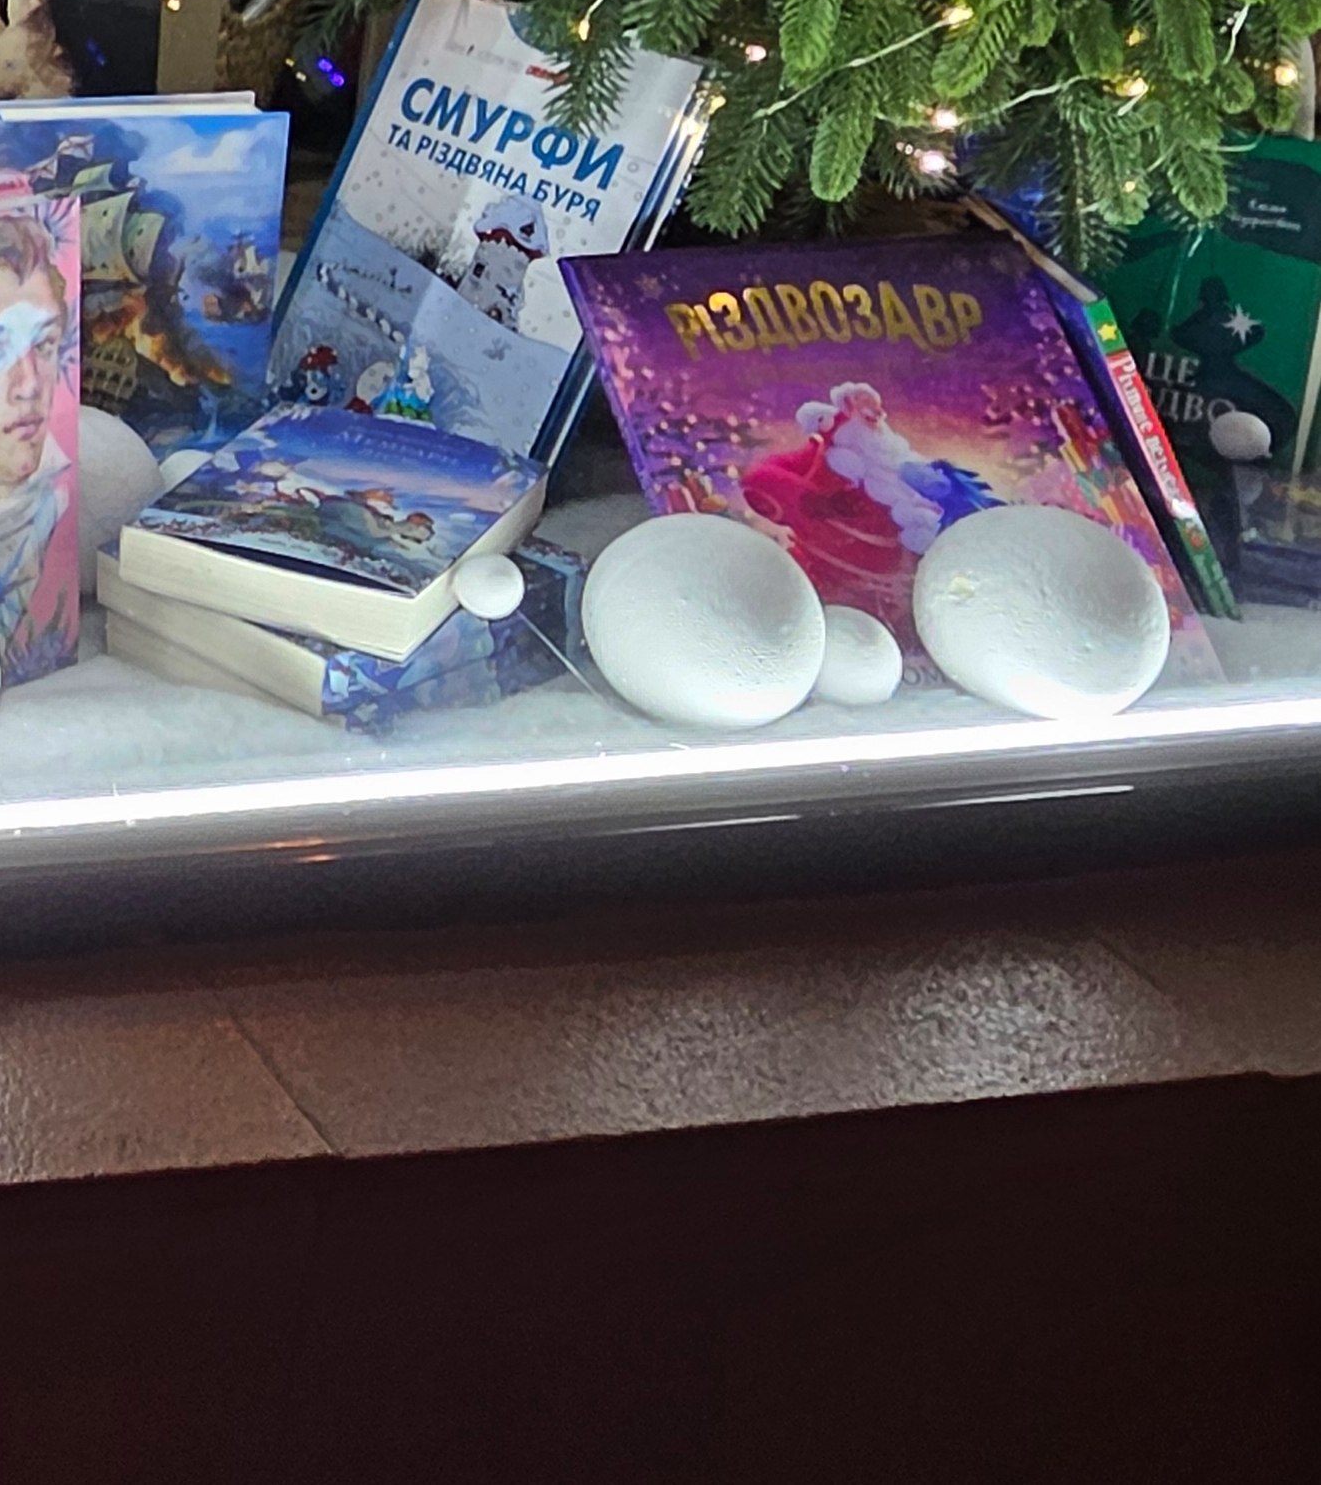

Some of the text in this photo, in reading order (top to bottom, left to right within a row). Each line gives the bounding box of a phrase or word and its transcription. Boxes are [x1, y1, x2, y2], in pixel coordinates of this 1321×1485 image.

[387, 123, 602, 223] ТА РІЗДВЯНА БУРЯ
[401, 77, 625, 191] СМУРФИ
[666, 280, 983, 361] РІЗДВОЗАВР
